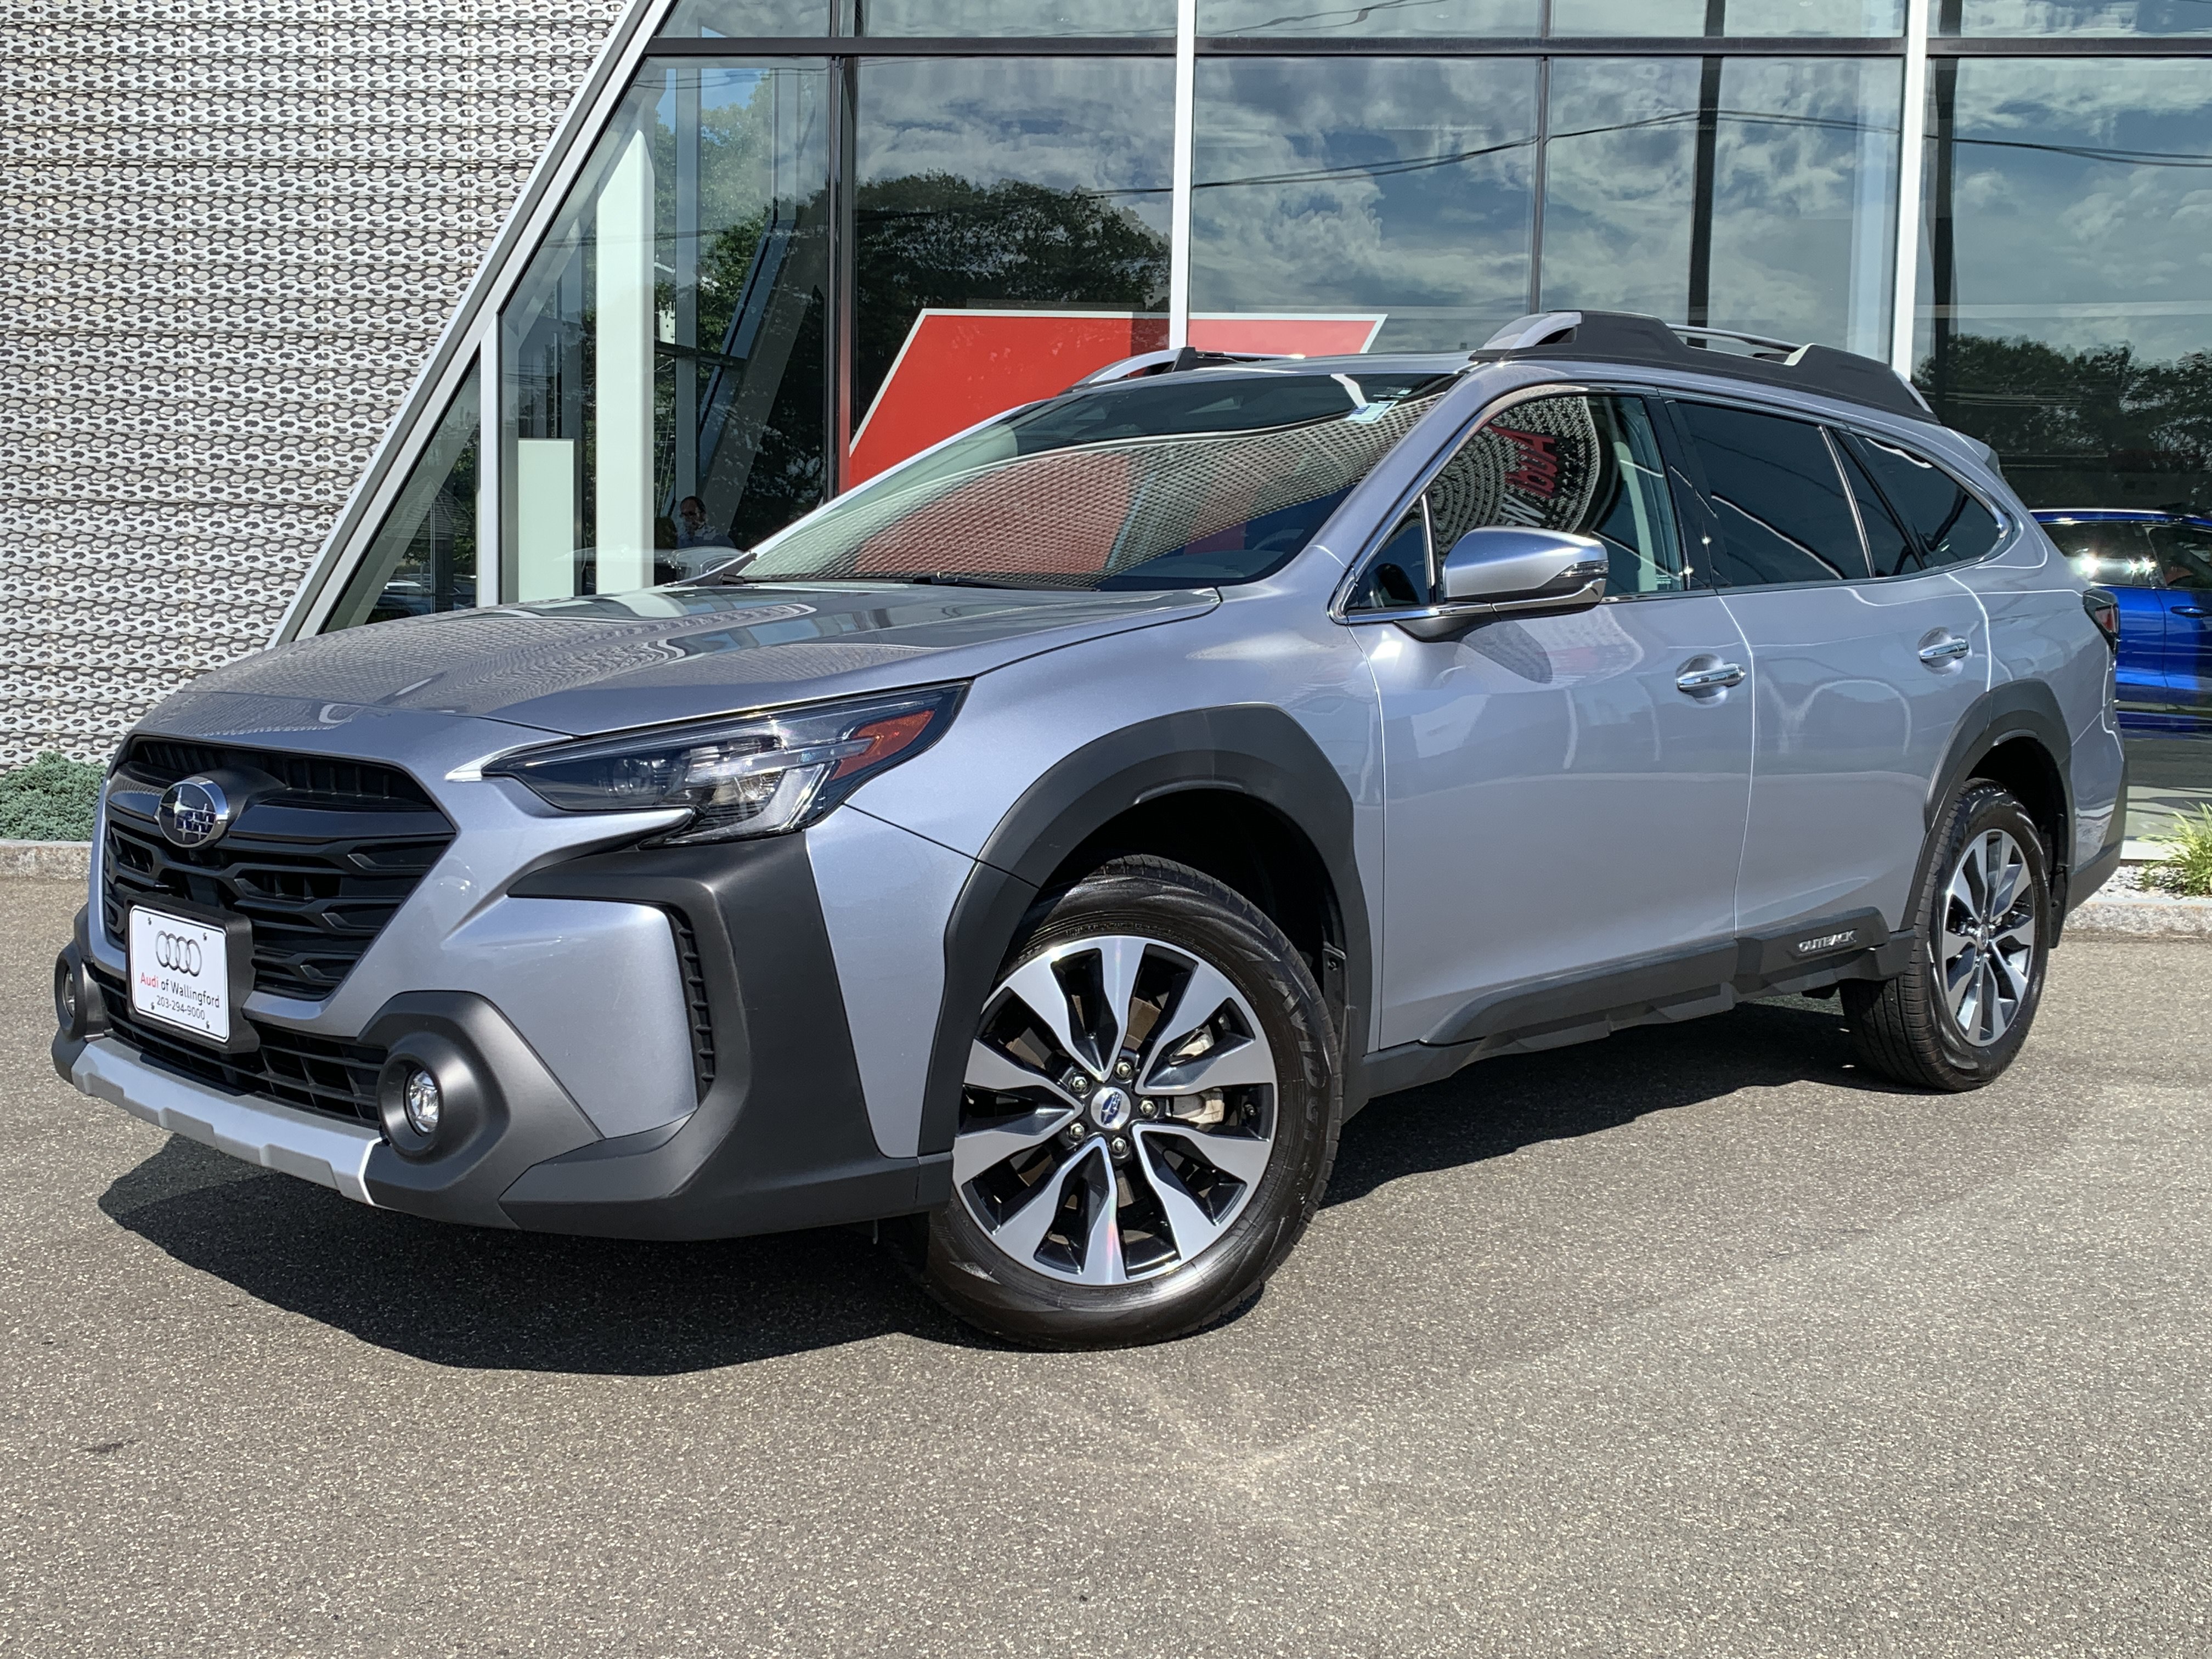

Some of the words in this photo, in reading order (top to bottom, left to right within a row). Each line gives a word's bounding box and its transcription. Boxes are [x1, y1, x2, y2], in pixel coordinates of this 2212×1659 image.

[1799, 930, 1855, 952] OUTBACK
[140, 972, 159, 988] Audi
[161, 979, 170, 991] of
[171, 981, 219, 1008] Wallingford
[156, 995, 205, 1020] 203-294-9000
